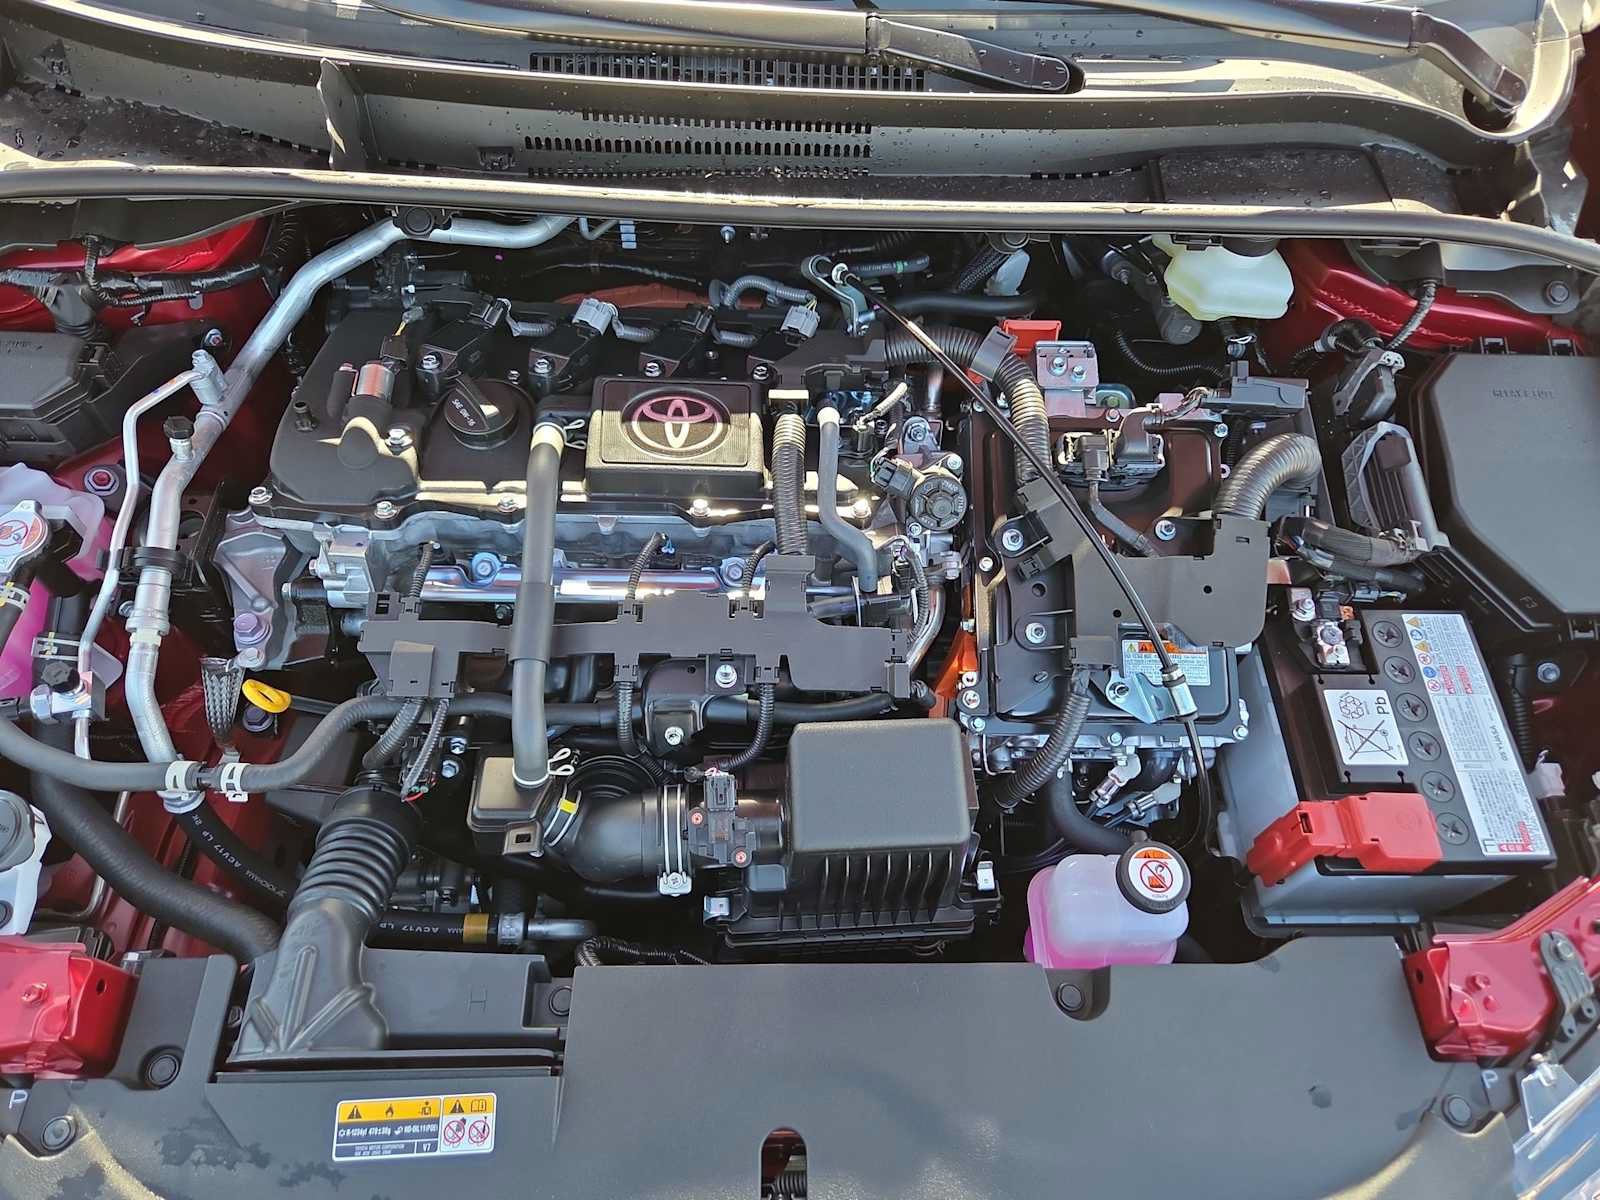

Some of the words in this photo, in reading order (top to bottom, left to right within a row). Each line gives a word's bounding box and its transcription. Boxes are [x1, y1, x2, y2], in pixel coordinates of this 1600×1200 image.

[460, 408, 476, 427] 0W-16
[1374, 696, 1390, 715] Pb
[1489, 724, 1503, 750] YUASA
[202, 830, 214, 841] LP
[213, 844, 241, 868] ACV17
[402, 922, 439, 933] ACV17
[1481, 1069, 1499, 1089] P
[9, 1089, 28, 1109] P
[422, 1143, 431, 1151] V7
